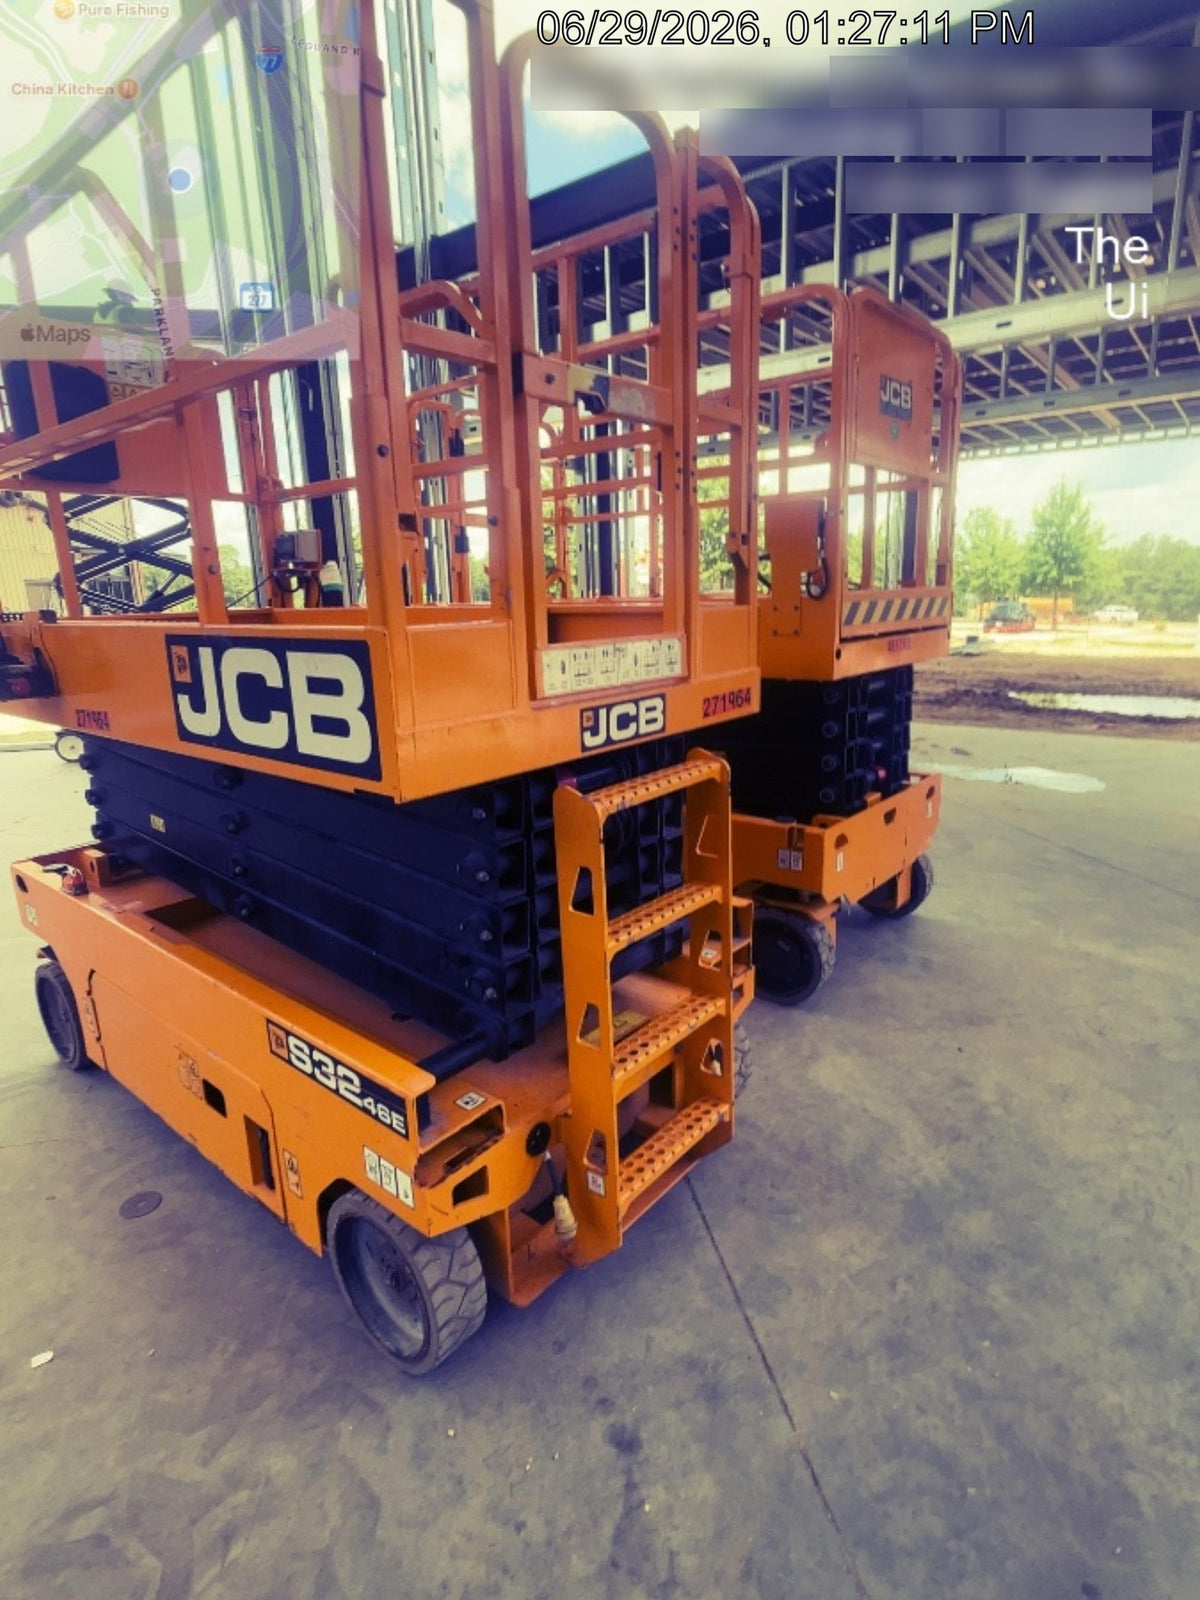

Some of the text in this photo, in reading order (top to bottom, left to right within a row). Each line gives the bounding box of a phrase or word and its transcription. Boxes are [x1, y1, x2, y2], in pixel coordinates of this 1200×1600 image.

[881, 377, 911, 411] JCB
[176, 646, 373, 764] JCB
[582, 696, 665, 748] JCB
[703, 688, 751, 718] 271964
